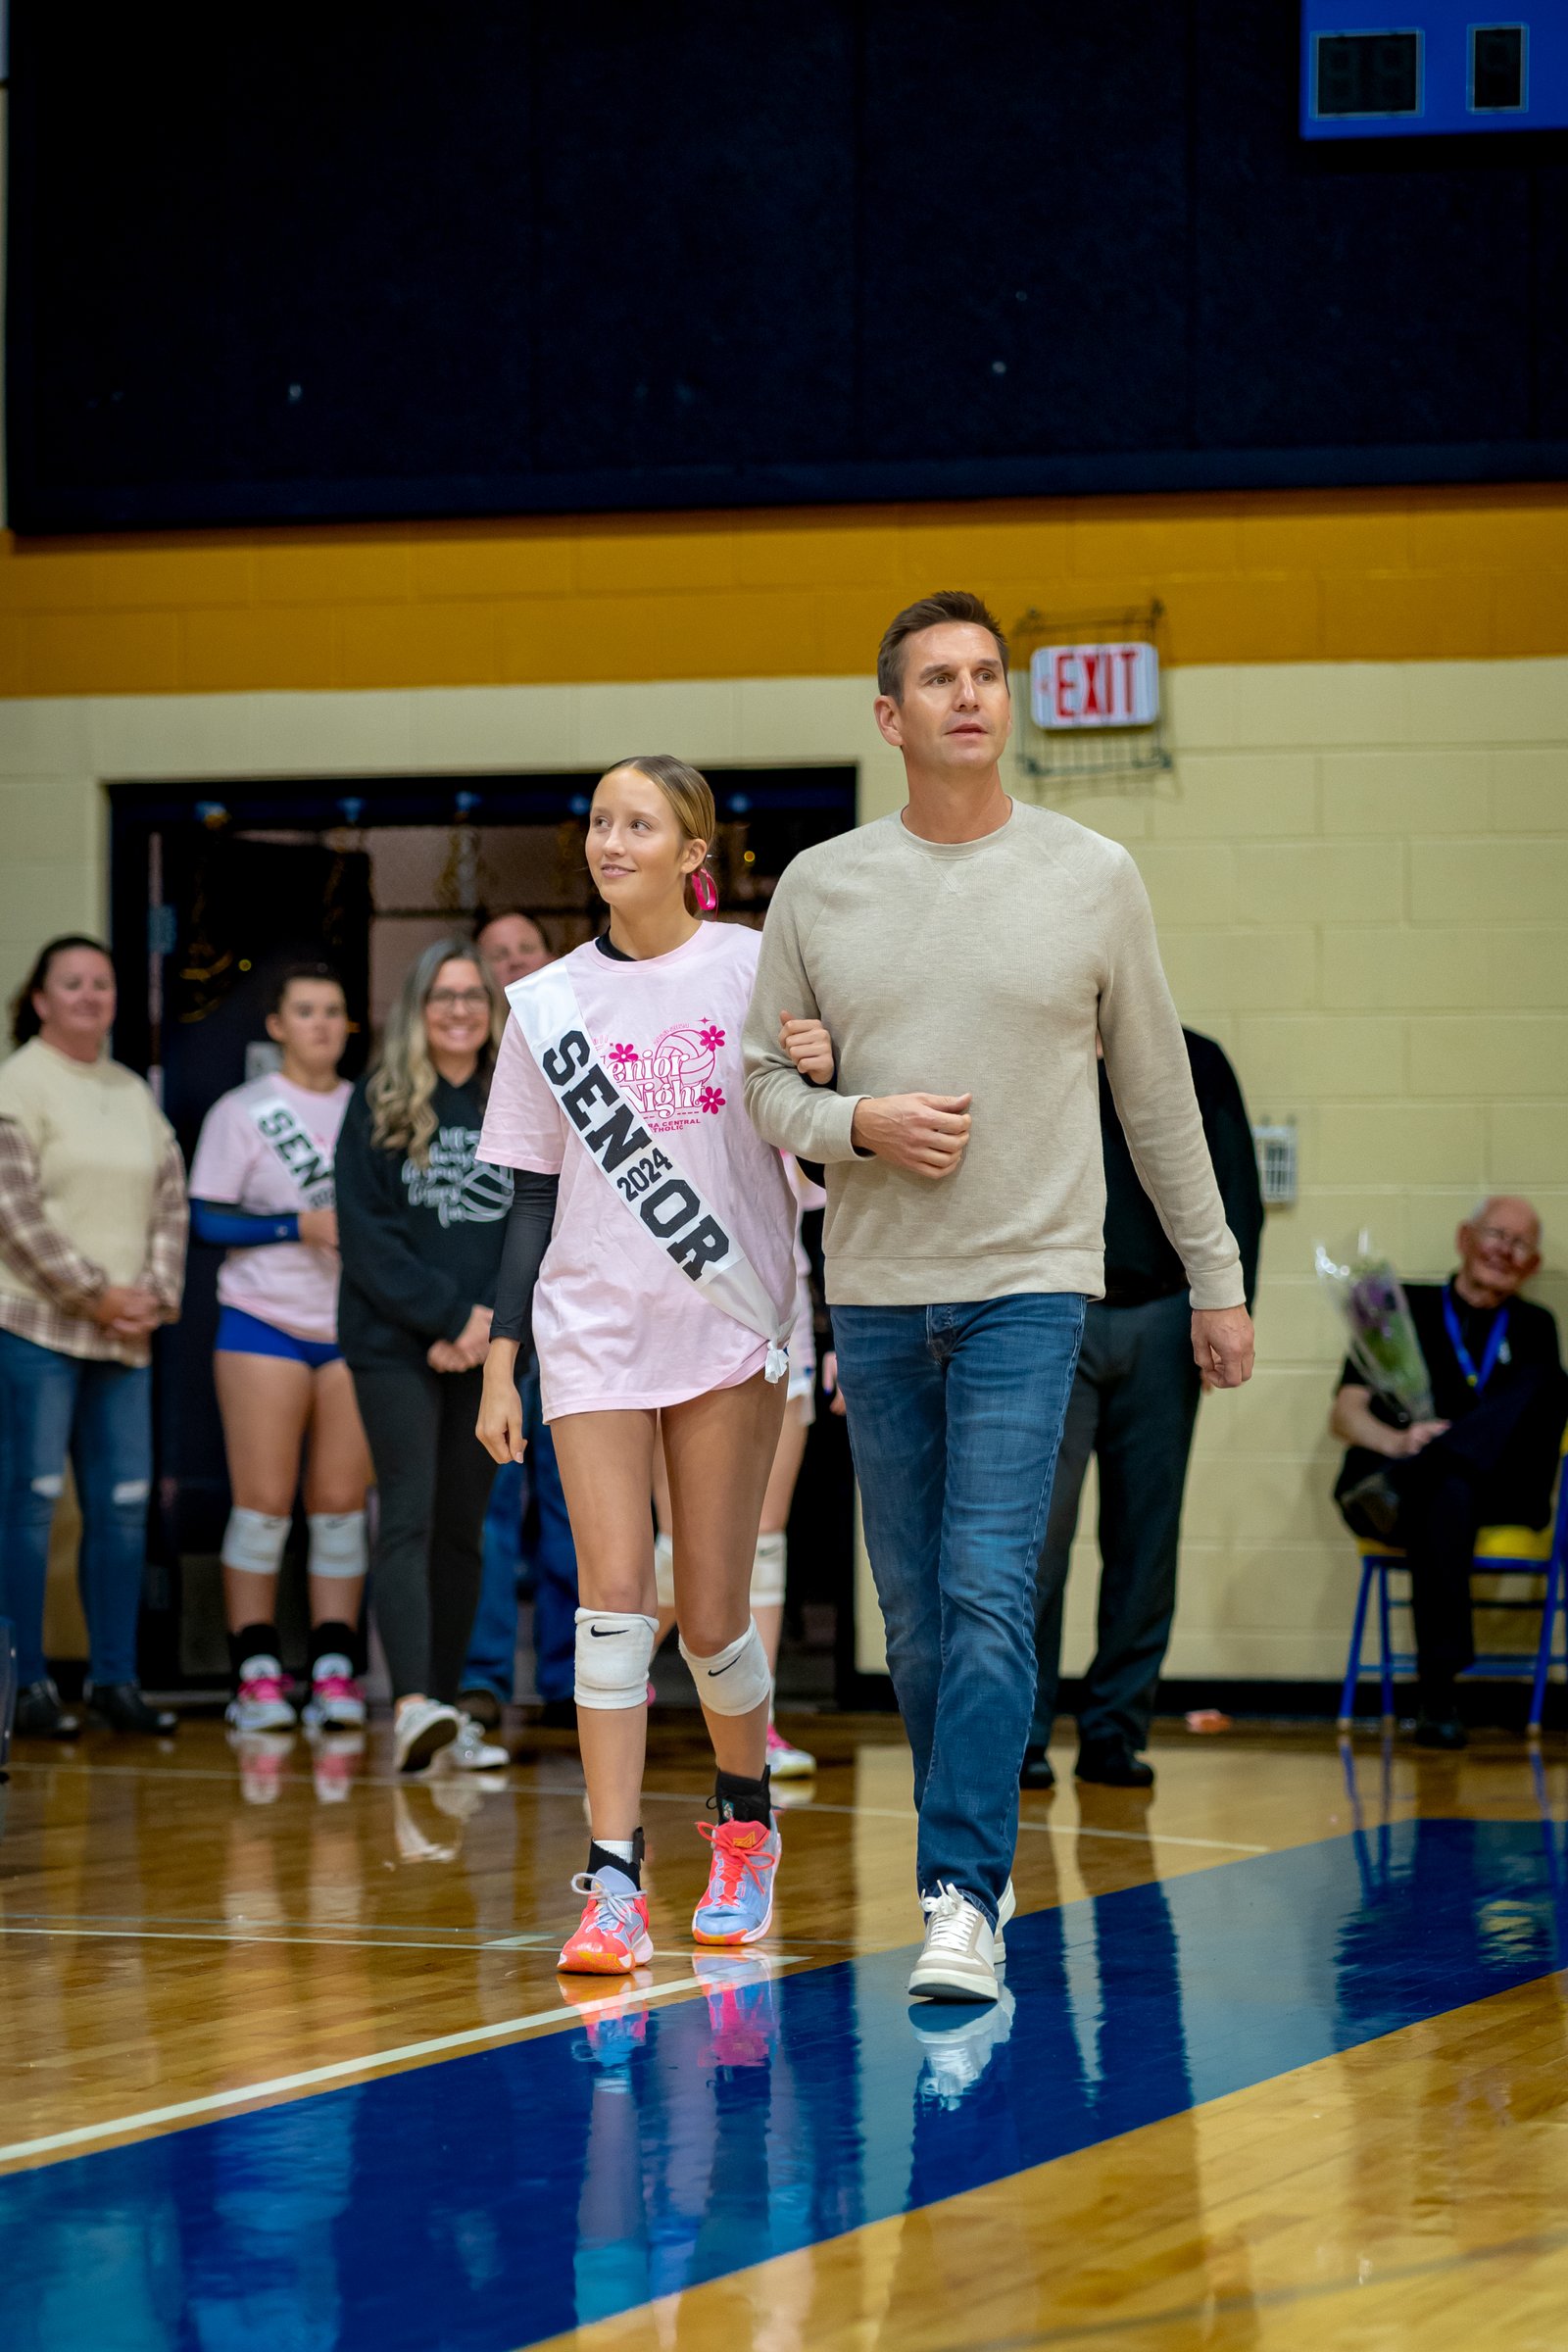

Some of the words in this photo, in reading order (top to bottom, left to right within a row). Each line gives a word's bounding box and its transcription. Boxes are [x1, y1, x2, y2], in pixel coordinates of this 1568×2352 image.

[1054, 650, 1139, 718] EXIT
[606, 1049, 691, 1084] enior
[652, 1124, 684, 1133] THOLIC
[662, 1118, 702, 1128] CENTRAL
[616, 1147, 673, 1202] 2024
